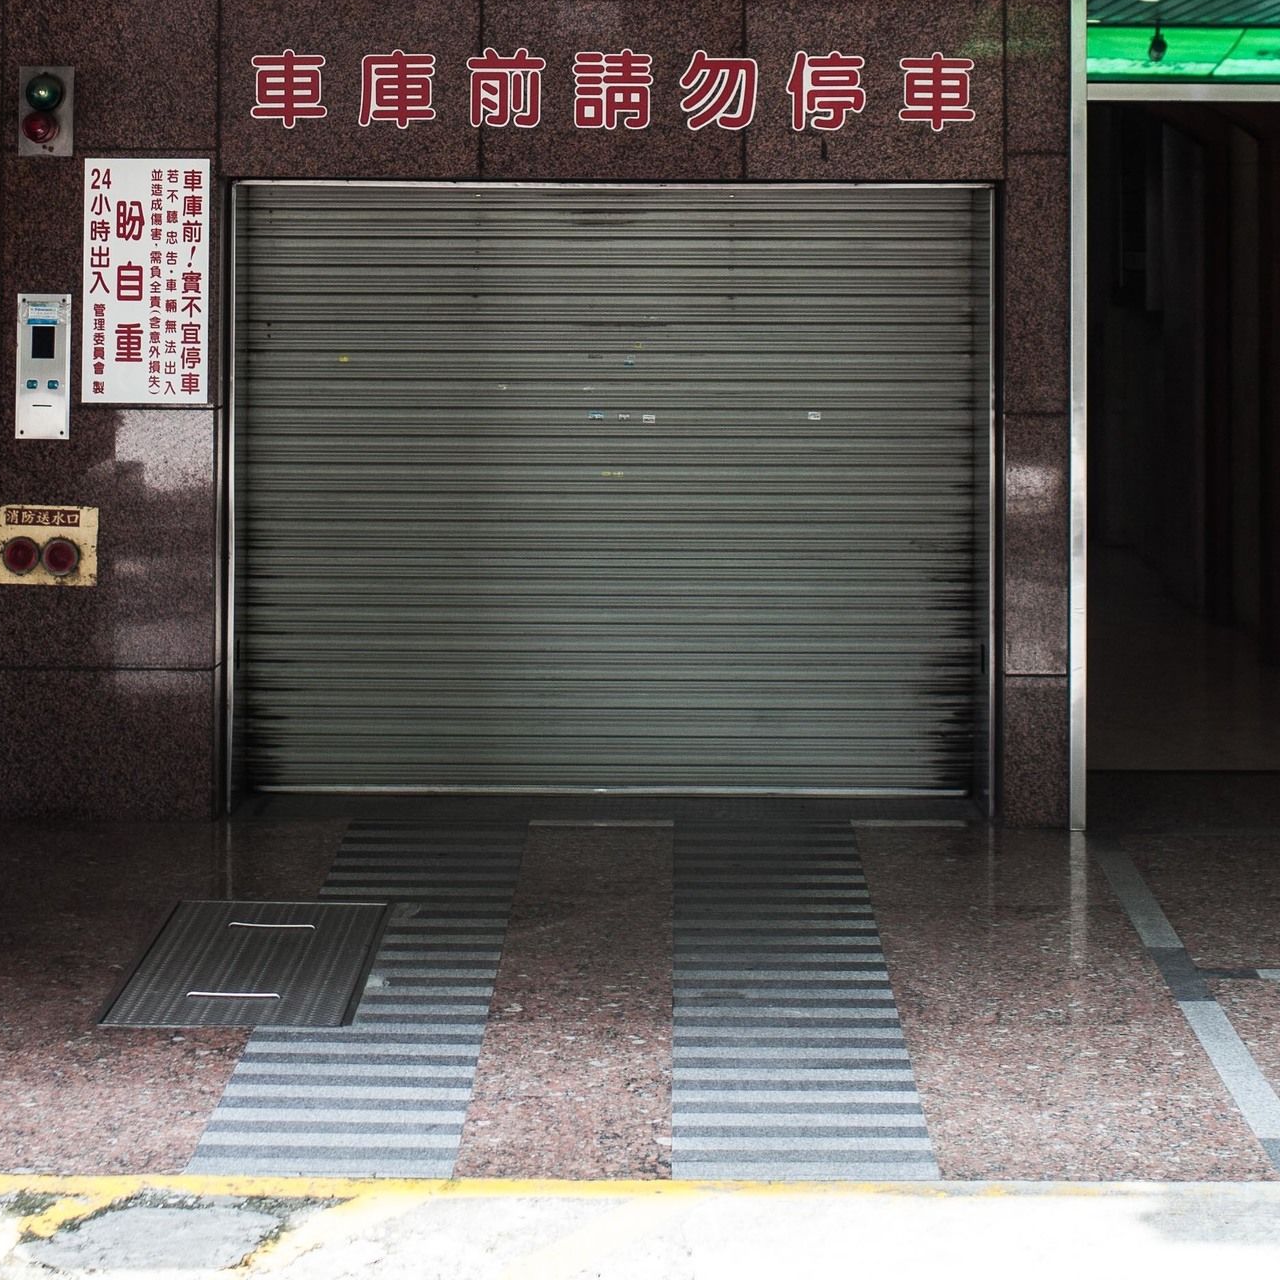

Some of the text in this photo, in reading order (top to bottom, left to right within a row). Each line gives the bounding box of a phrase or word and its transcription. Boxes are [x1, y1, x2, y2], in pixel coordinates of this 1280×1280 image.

[251, 47, 976, 132] 車庫前請勿停車
[89, 168, 112, 294] 24小時出入
[114, 200, 145, 363] 盼自重
[92, 303, 106, 395] 管理委員會 製
[5, 508, 80, 525] 消防送水口
